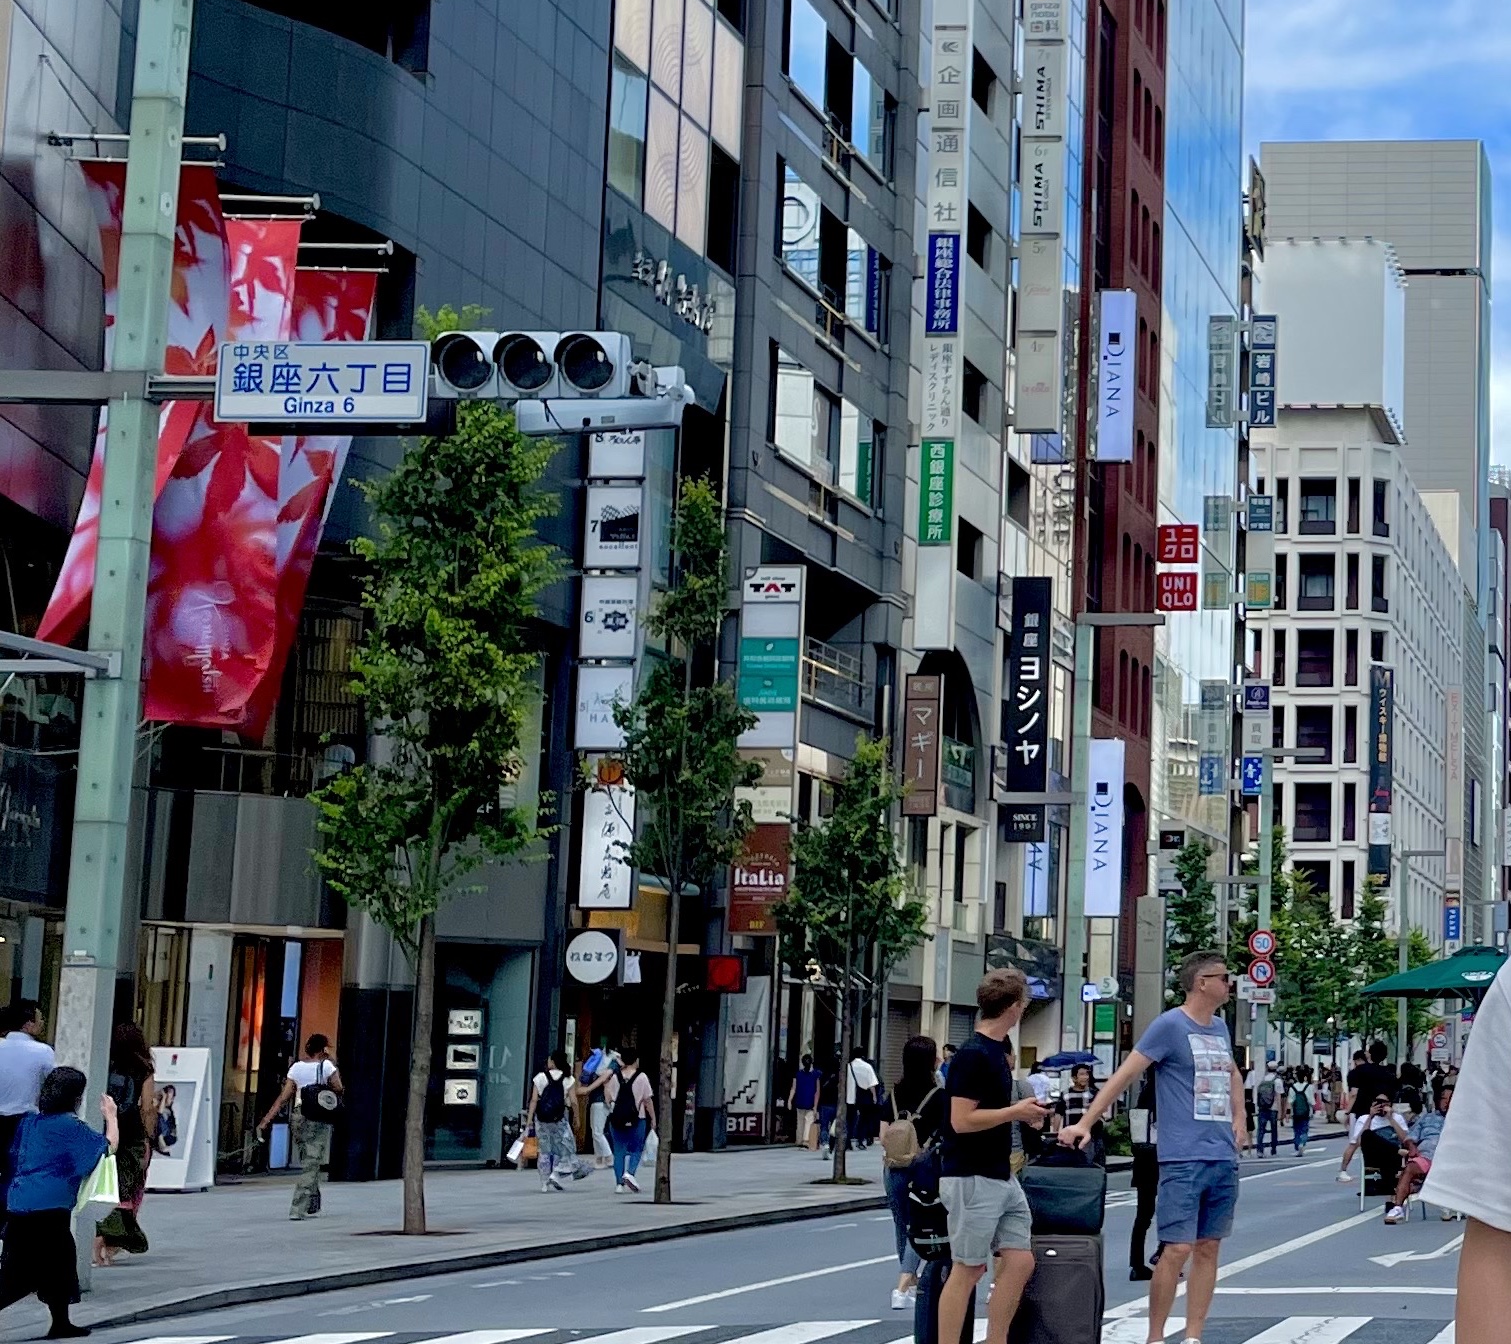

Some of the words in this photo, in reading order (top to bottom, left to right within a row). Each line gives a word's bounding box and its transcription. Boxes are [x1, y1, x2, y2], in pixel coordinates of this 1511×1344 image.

[1035, 65, 1046, 131] SHIMA
[933, 64, 962, 223] 企画通信社
[1033, 162, 1044, 227] SHIMA
[233, 344, 290, 360] 中央区
[232, 361, 412, 394] 銀座六丁目
[1104, 339, 1126, 418] DIANA
[283, 397, 335, 414] Ginza
[343, 398, 355, 413] 6
[927, 443, 946, 540] 西銀座診療所
[590, 520, 599, 533] 7
[1164, 528, 1195, 541] ユニ
[1164, 544, 1195, 558] クロ
[750, 583, 796, 593] TAT
[1162, 576, 1192, 591] UNI
[1162, 592, 1193, 607] QLO
[584, 611, 594, 623] 6
[1023, 612, 1040, 648] 銀座
[1015, 656, 1042, 766] ヨシノヤ
[911, 706, 935, 778] マギー
[1092, 791, 1114, 872] DIANA
[1255, 937, 1270, 950] 50
[1102, 977, 1110, 988] 5
[726, 1116, 758, 1132] B1F
